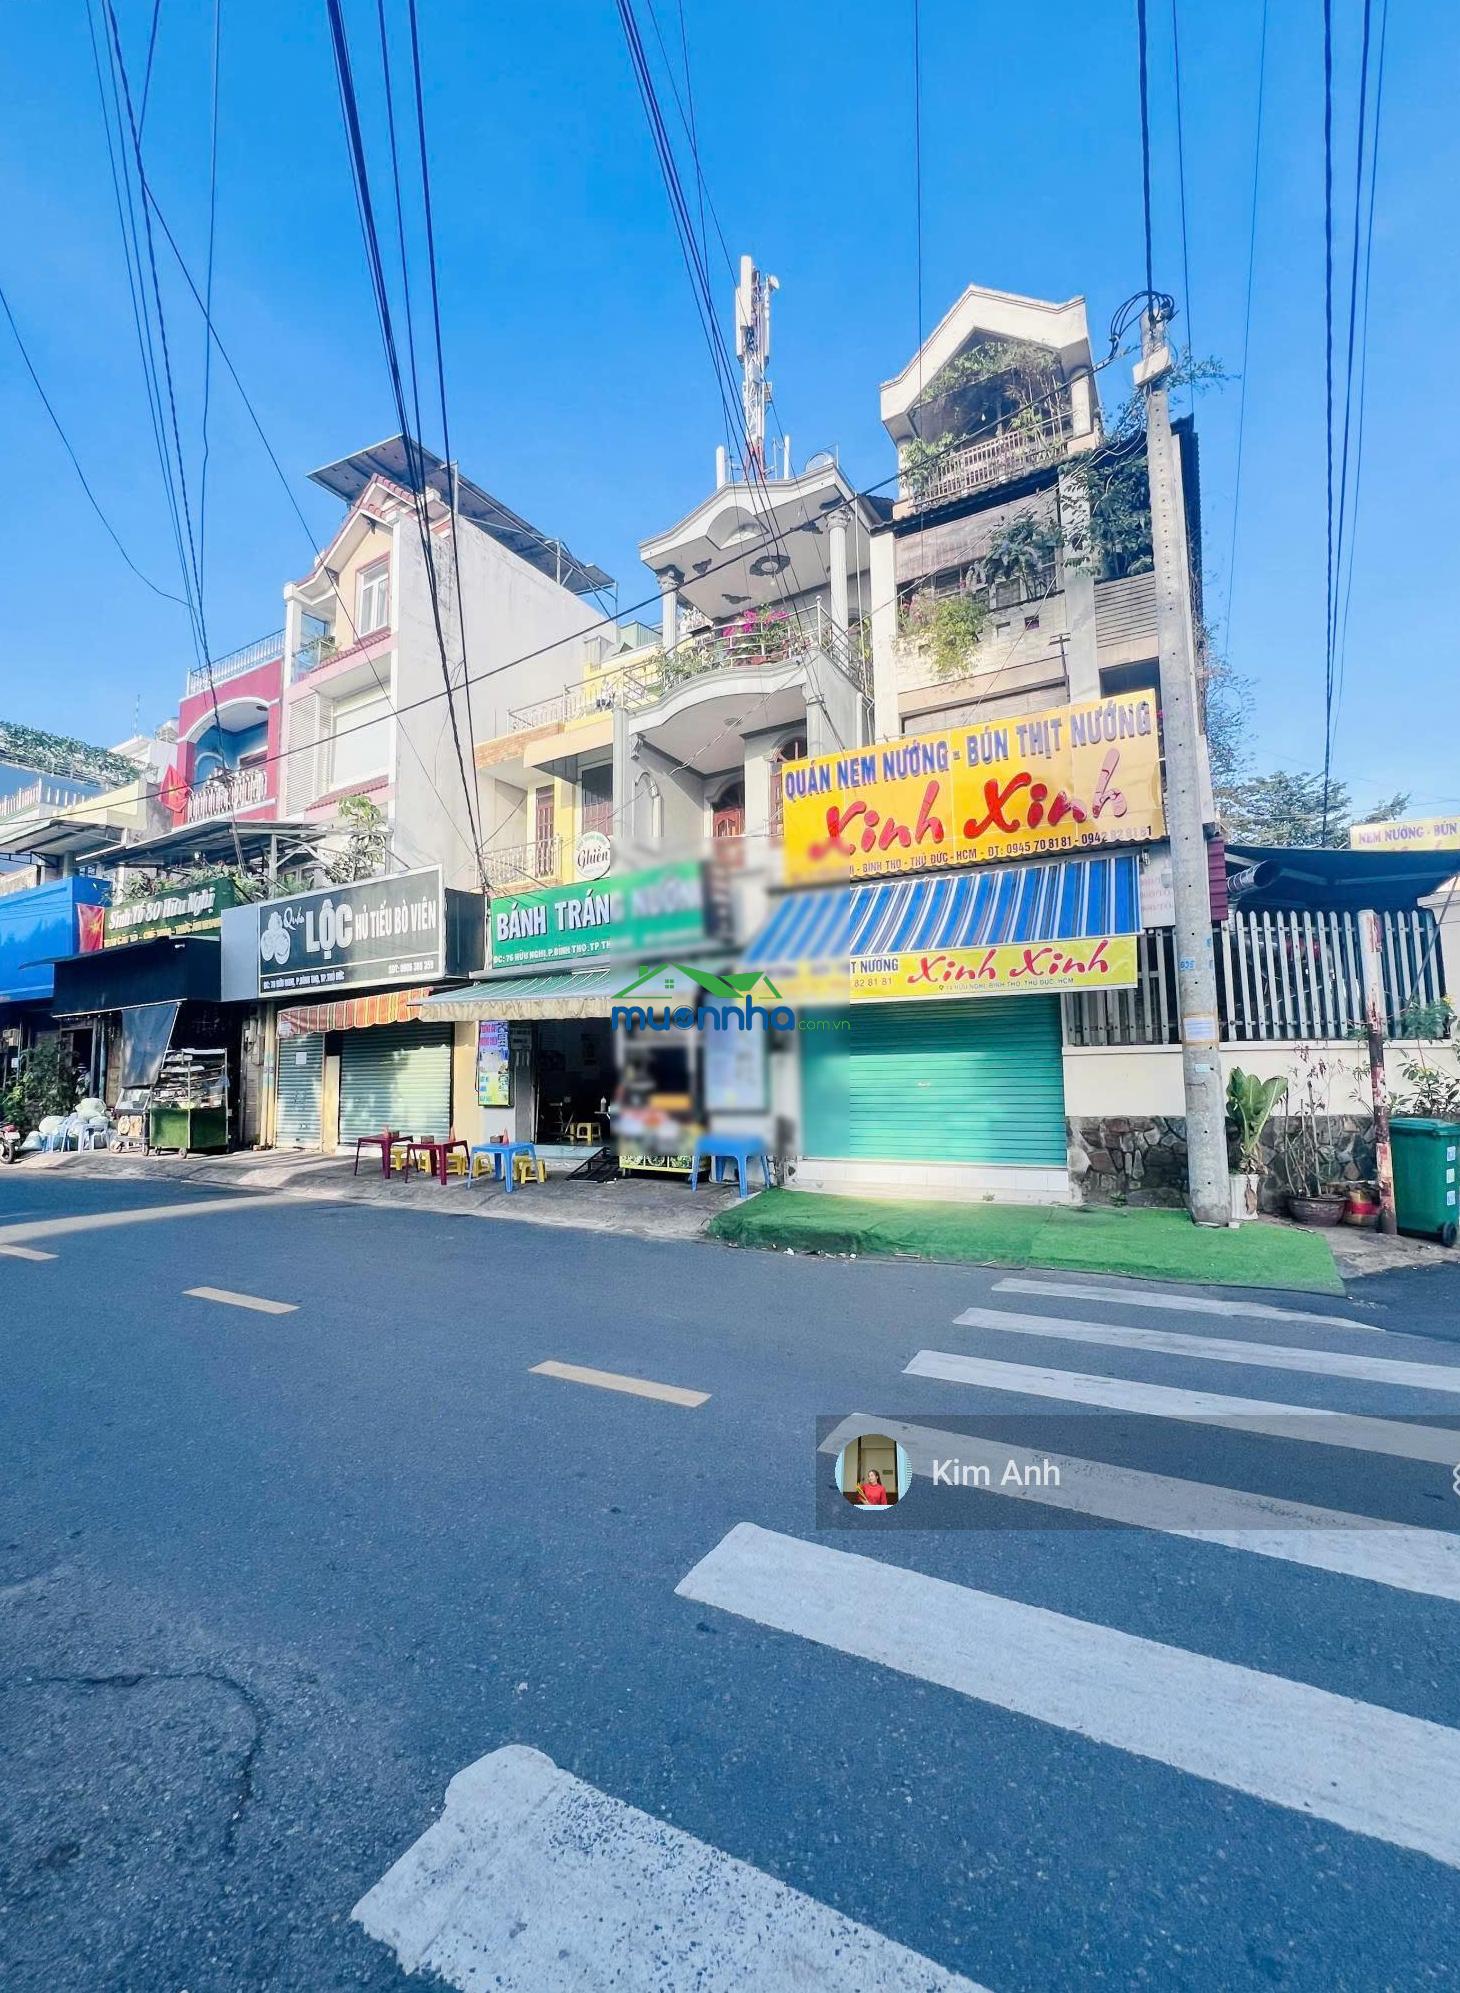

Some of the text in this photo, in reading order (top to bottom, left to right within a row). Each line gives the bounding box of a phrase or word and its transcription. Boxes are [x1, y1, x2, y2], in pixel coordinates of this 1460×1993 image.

[785, 760, 832, 802] QUÁN
[882, 738, 950, 783] NƯỚNG
[966, 725, 1009, 767] BÚN
[1016, 717, 1062, 759] THỊT
[1070, 700, 1152, 749] NƯỚNG
[808, 748, 1127, 861] Xinh Xinh
[956, 848, 977, 861] HCM
[1006, 841, 1031, 855] 0945
[305, 896, 437, 960] LỘC HỦ TIẾU BÒ VIÊN
[496, 902, 547, 942] BÁNH
[907, 940, 1109, 983] Xinh Xinh
